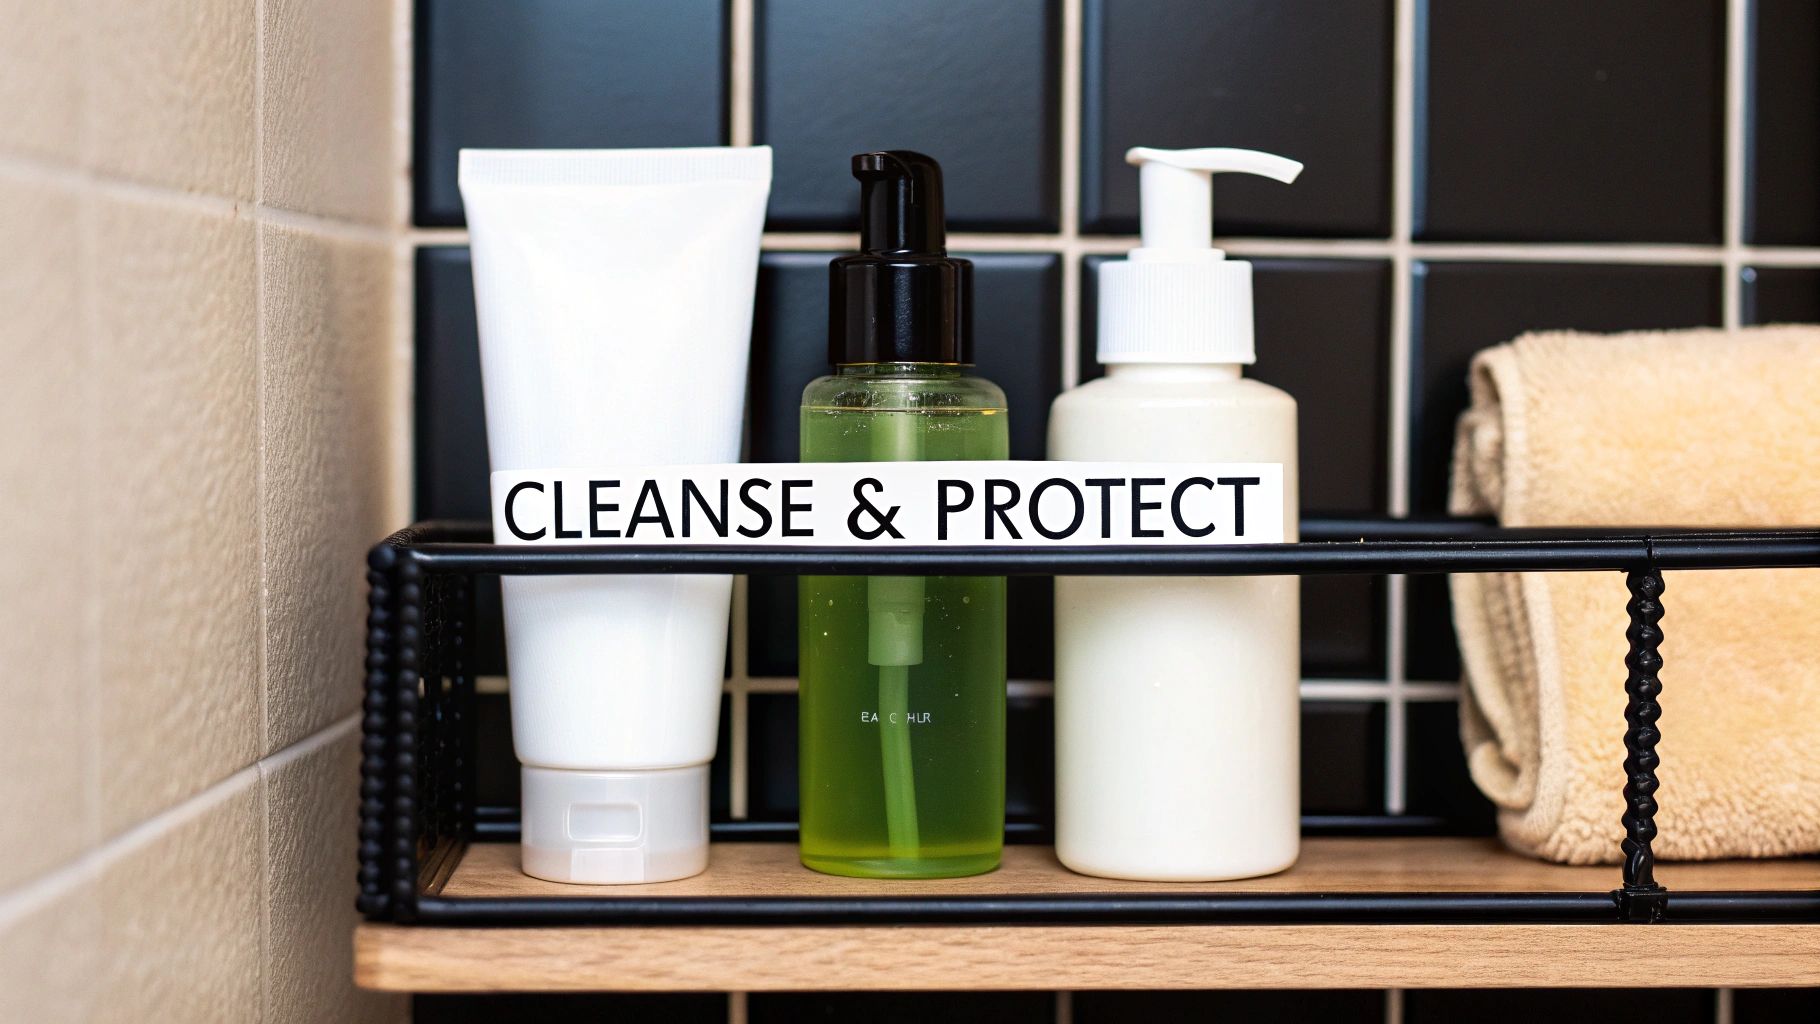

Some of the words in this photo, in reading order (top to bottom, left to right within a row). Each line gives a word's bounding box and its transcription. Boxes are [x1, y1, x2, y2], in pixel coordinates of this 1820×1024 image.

[504, 478, 814, 541] CLEANSE
[847, 477, 906, 541] &
[937, 476, 1261, 541] PROTECT
